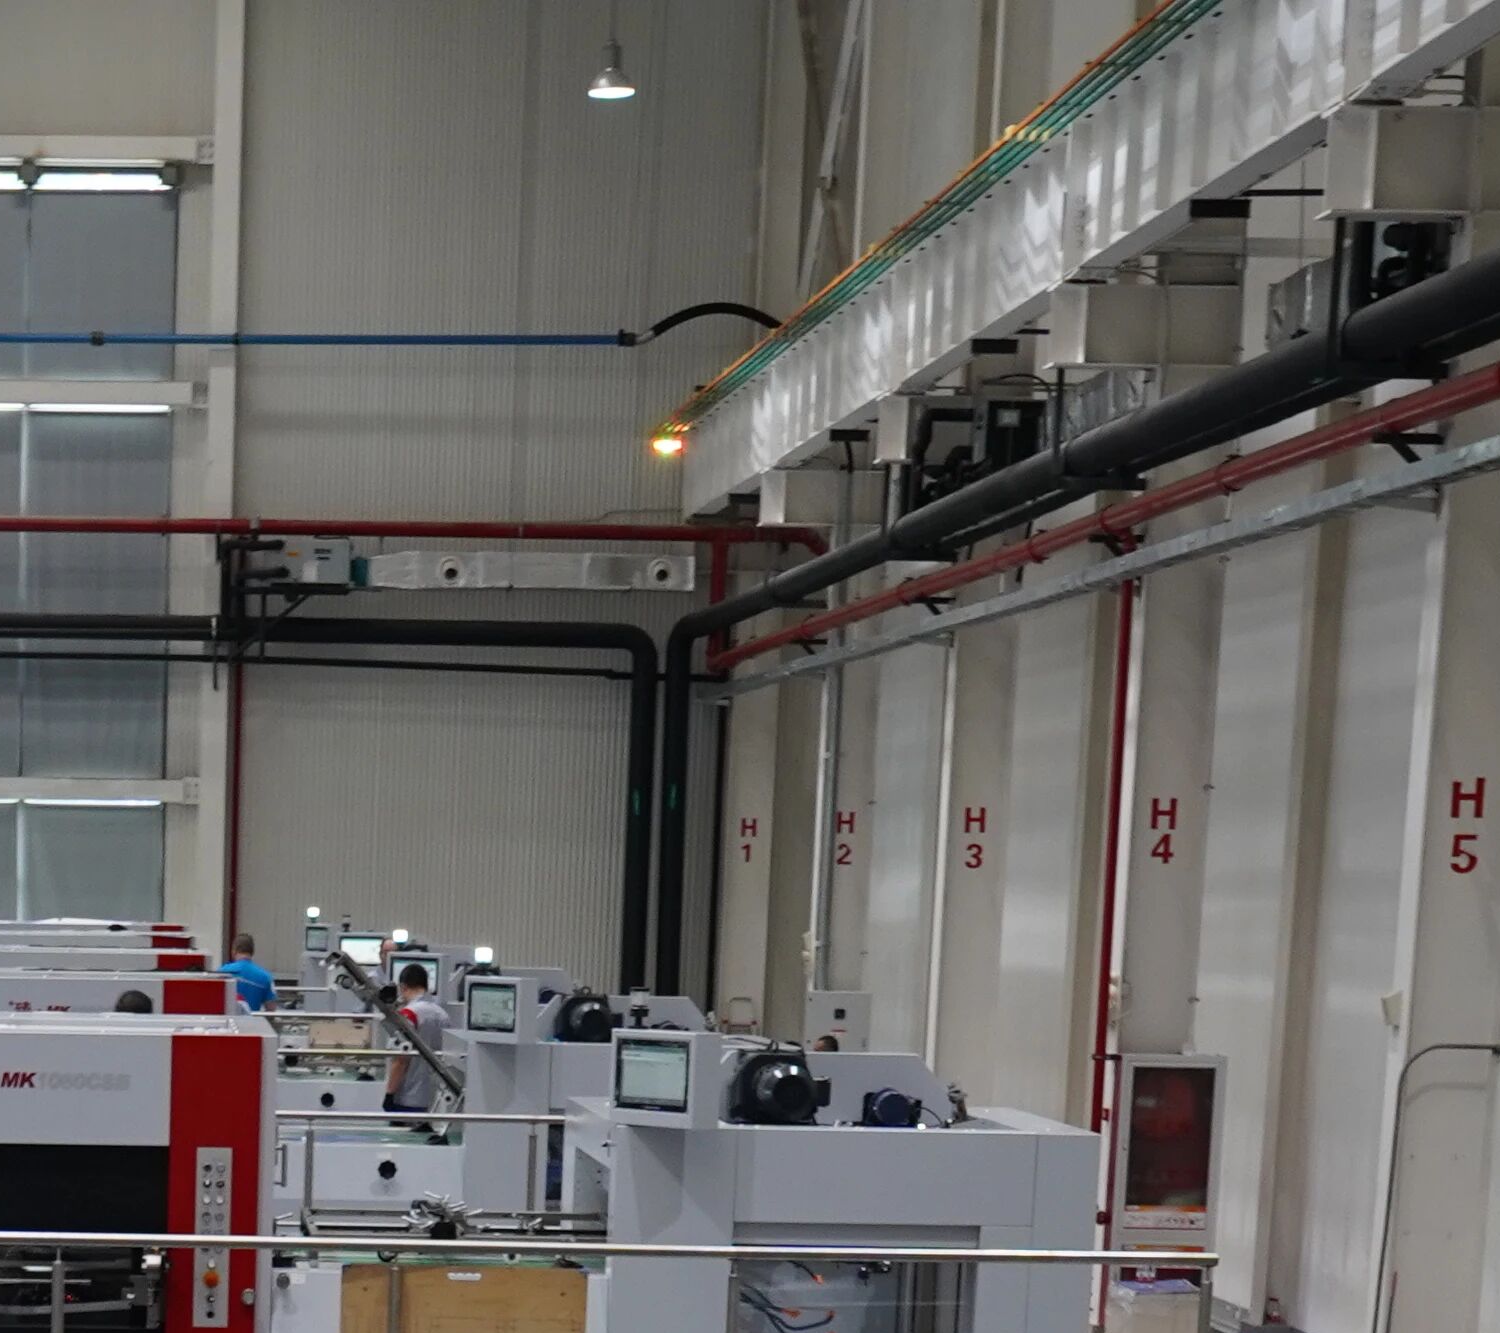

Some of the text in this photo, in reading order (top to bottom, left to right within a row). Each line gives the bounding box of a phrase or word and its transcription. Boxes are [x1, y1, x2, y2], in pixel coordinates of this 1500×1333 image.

[1449, 776, 1488, 818] H
[836, 811, 856, 834] H
[963, 806, 988, 833] H
[1149, 796, 1179, 831] H
[740, 817, 759, 838] H
[741, 843, 753, 863] 1
[836, 843, 853, 866] 2
[964, 843, 985, 870] 3
[1149, 833, 1176, 865] 4
[1449, 832, 1480, 875] 5
